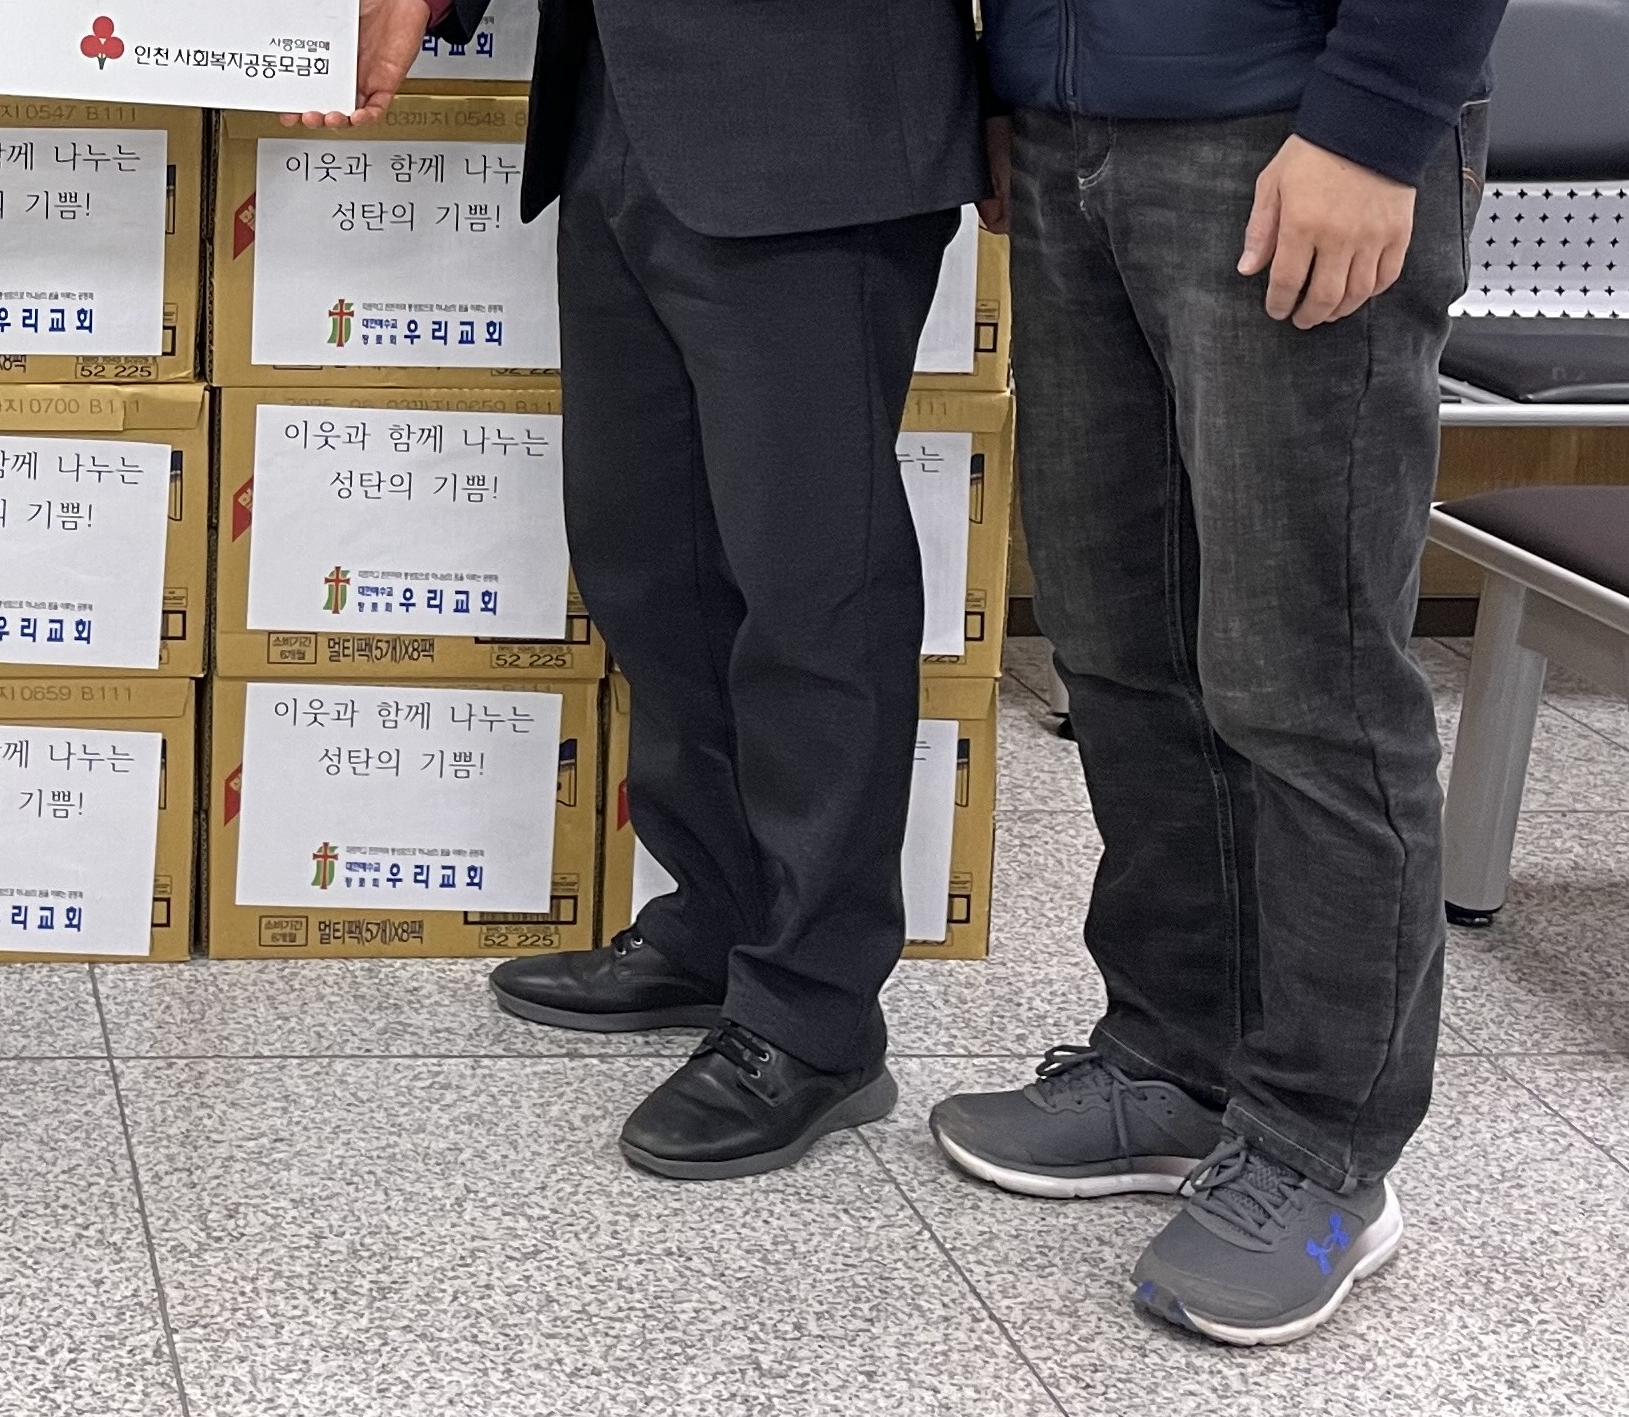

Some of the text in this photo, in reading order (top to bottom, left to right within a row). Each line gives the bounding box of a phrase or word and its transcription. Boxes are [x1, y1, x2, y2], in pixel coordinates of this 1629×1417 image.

[134, 45, 330, 79] 인천 사회복지공동모금회
[53, 141, 141, 173] 나누는
[285, 151, 373, 183] 이웃과
[389, 153, 445, 184] 함께
[24, 190, 90, 221] 기쁨!
[331, 201, 500, 233] 성탄의 기쁨!
[403, 318, 503, 347] 우리교회
[80, 365, 152, 378] 52 225
[284, 419, 550, 458] 이웃과 함께 나누는
[57, 452, 144, 485] 나누는
[329, 469, 498, 503] 성탄의 기쁨!
[27, 500, 93, 531] 기쁨!
[398, 587, 499, 617] 우리교회
[494, 654, 567, 667] 52 225
[274, 697, 535, 734] 이웃과 함께 나누는
[48, 741, 135, 773] 나누는
[317, 746, 485, 780] 성탄의 기쁨!
[18, 788, 83, 819] 기쁨!
[385, 862, 484, 891] 우리교회
[483, 934, 554, 947] 52 225
